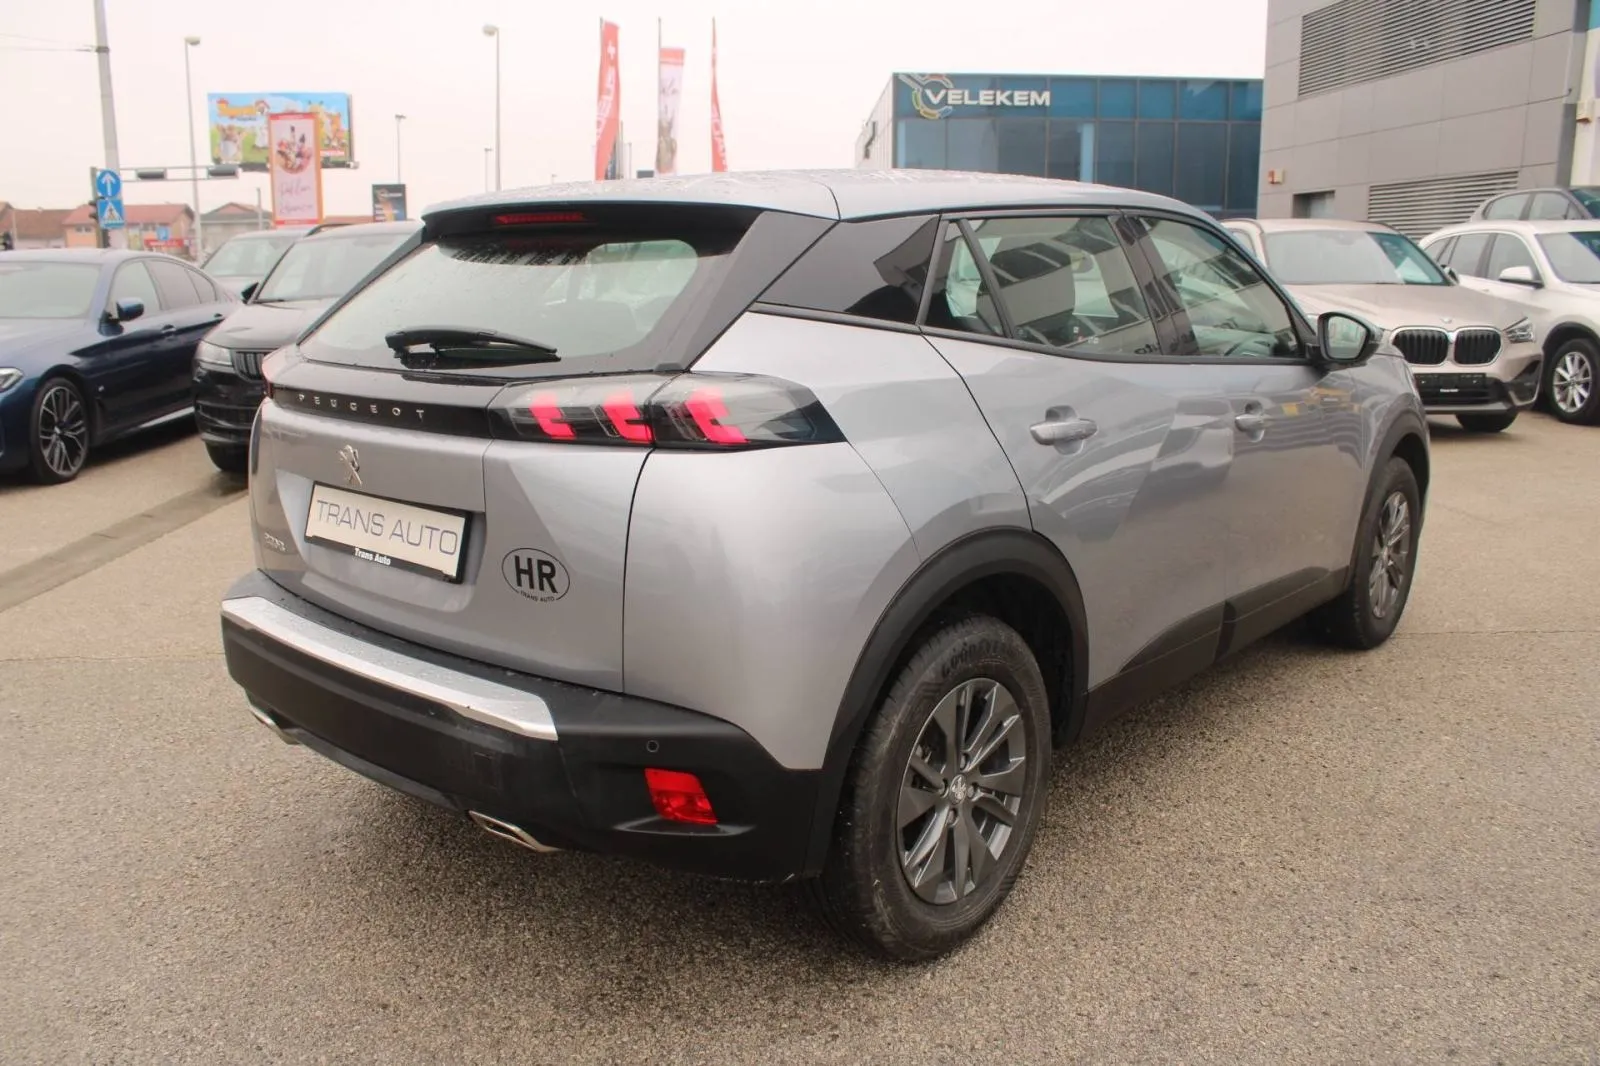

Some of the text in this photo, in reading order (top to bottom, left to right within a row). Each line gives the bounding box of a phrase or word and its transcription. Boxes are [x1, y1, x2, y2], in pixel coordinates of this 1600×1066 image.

[925, 89, 1050, 106] VELEKEM
[298, 393, 425, 420] PEUGEOT
[316, 500, 458, 555] TRANS AUTO
[354, 547, 391, 566] Trans Auto
[514, 555, 558, 593] HR
